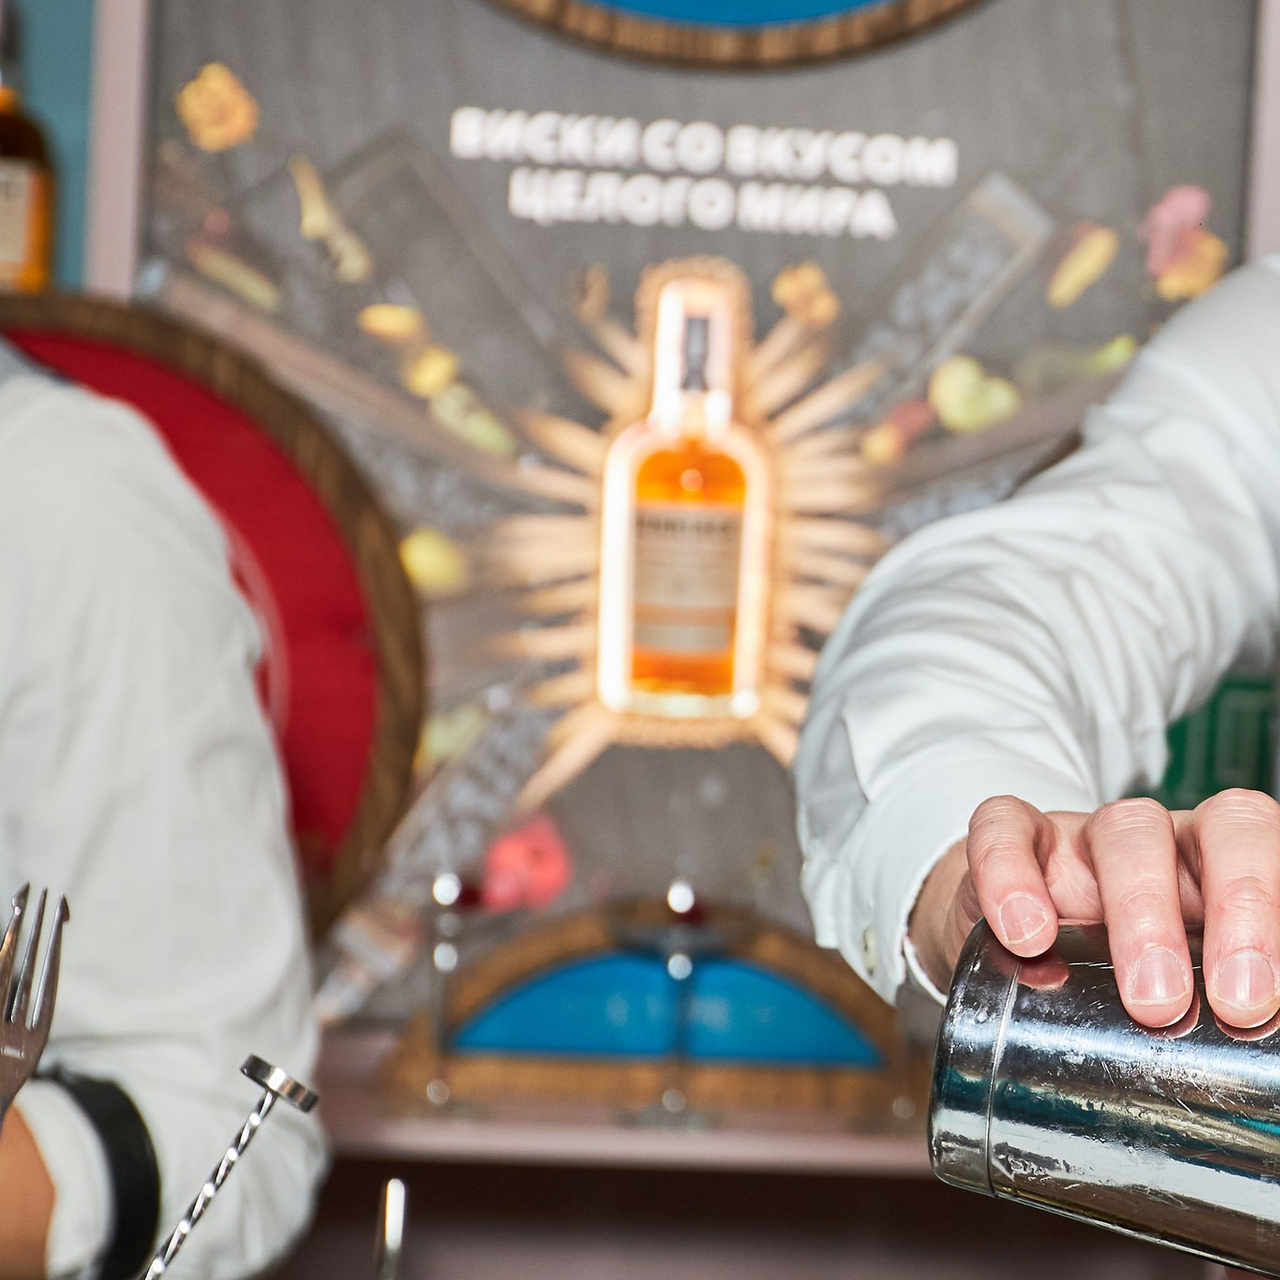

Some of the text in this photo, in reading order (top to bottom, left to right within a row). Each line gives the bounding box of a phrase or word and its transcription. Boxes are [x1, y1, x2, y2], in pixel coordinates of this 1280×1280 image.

[451, 106, 959, 188] ВИСКИ СО ВКУСОМ
[508, 166, 898, 241] ЦЕЛОГО МИРА
